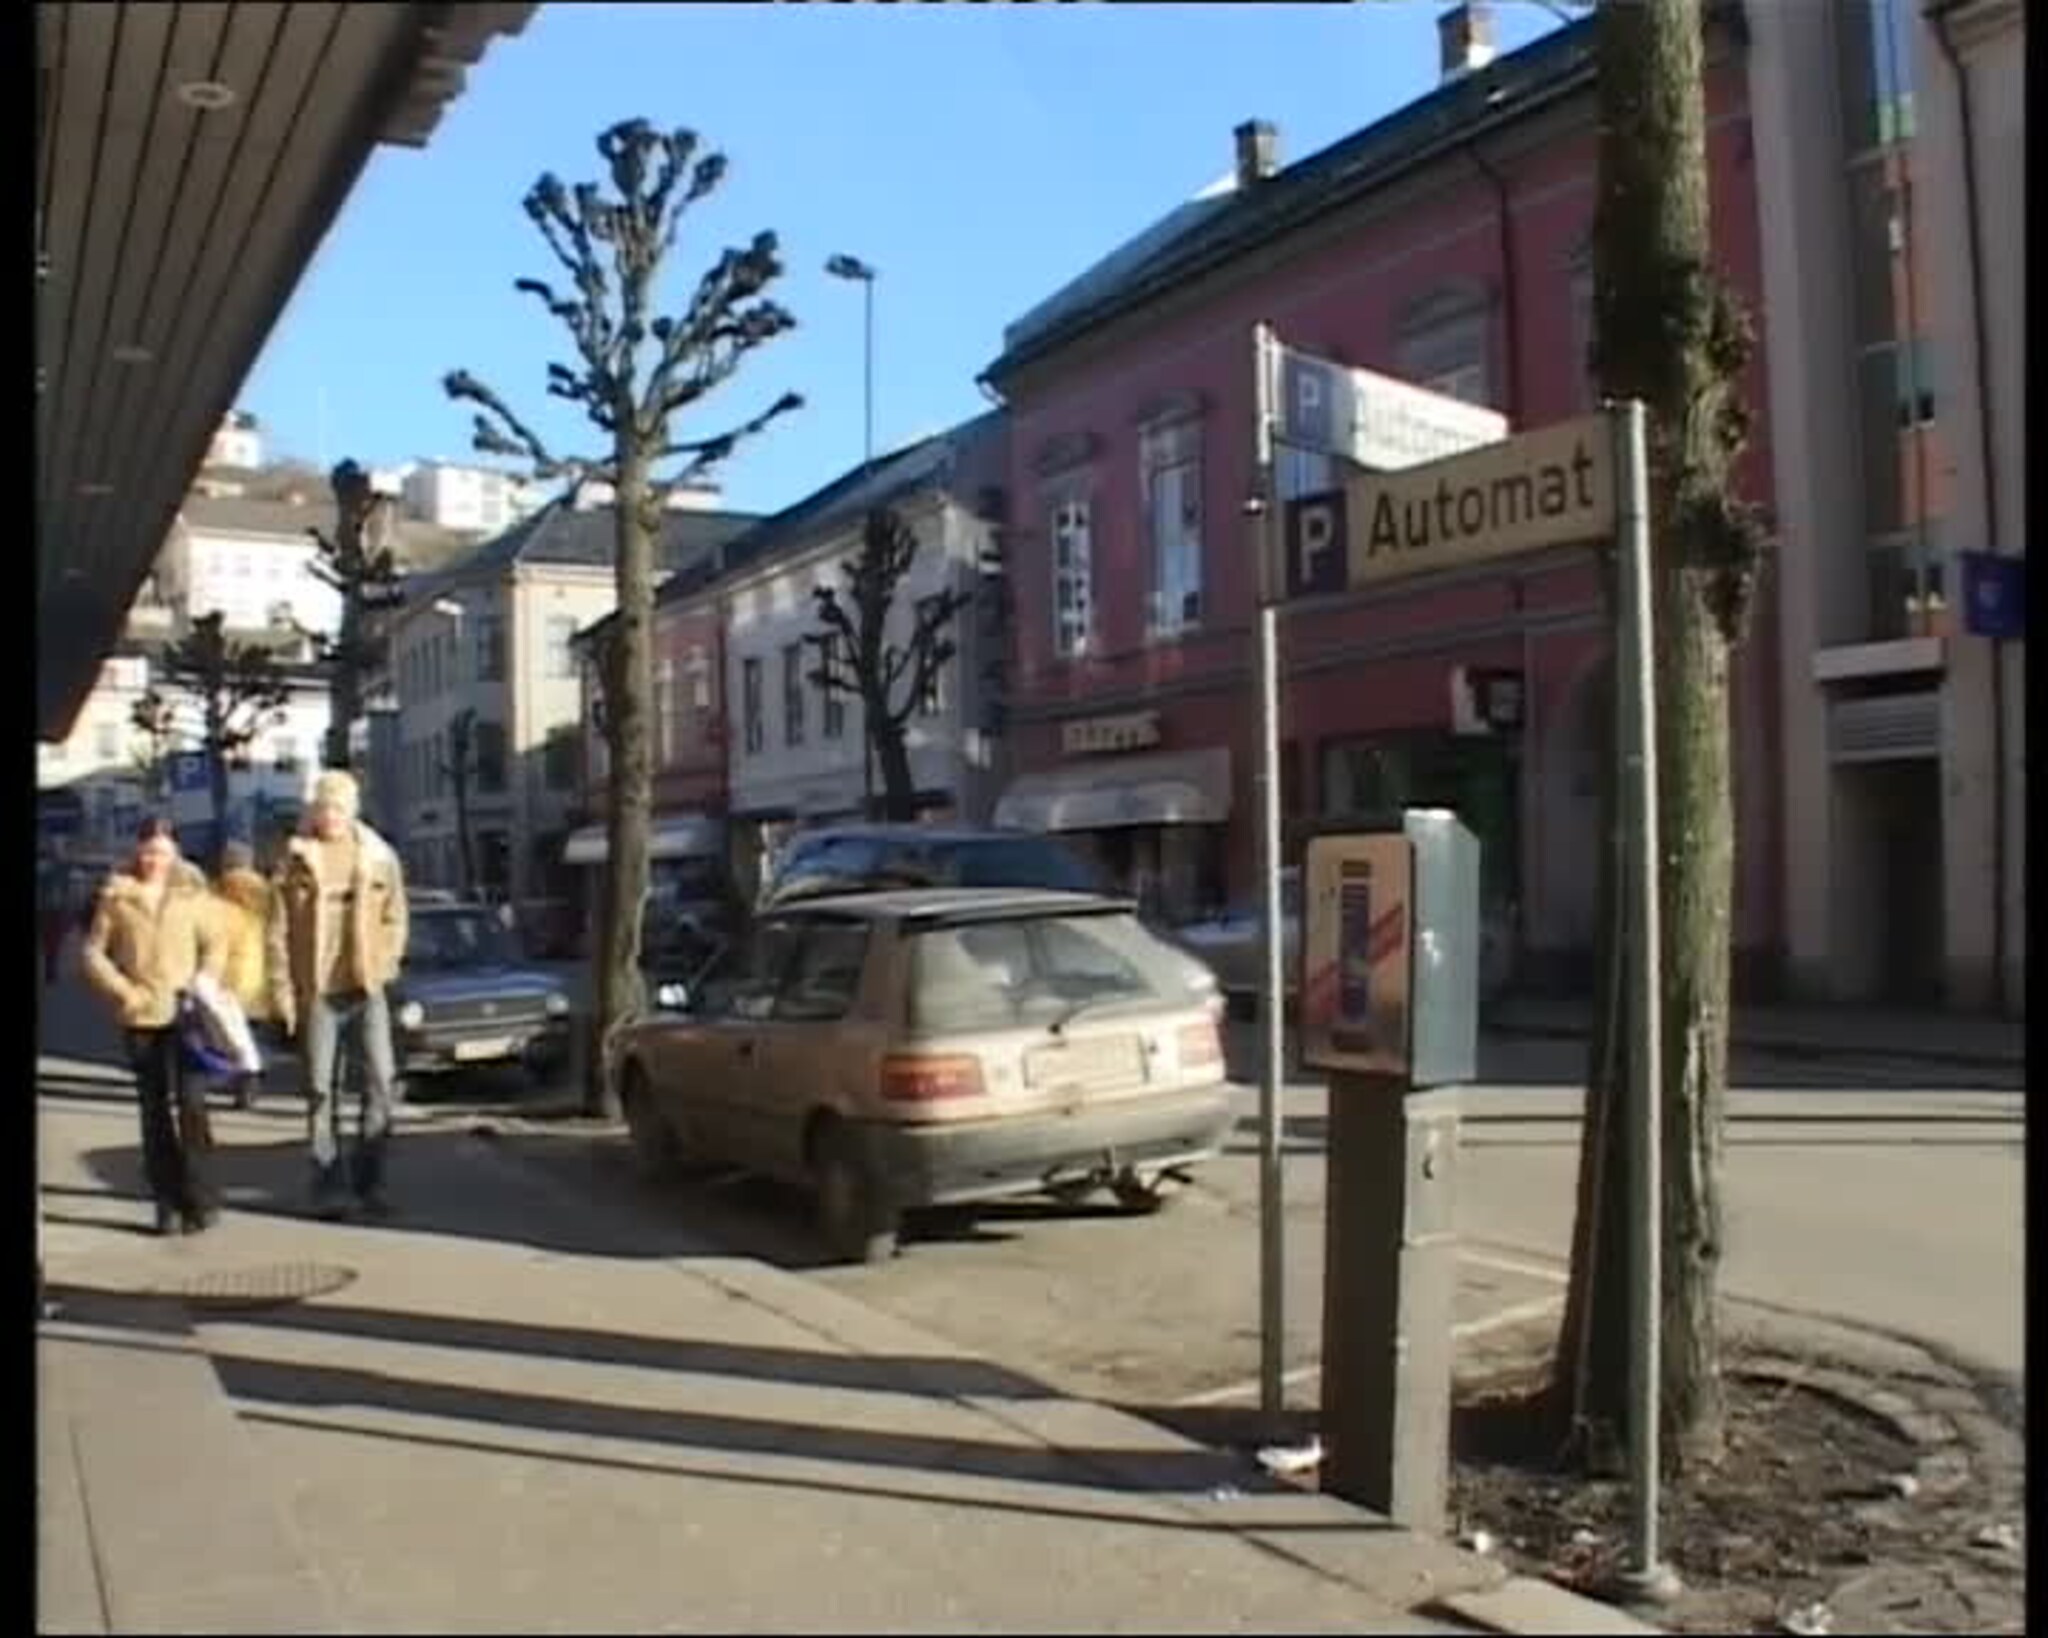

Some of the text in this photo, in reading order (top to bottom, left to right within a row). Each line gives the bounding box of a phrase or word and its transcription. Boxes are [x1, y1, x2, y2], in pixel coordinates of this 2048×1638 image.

[1297, 371, 1321, 432] P
[1301, 442, 1594, 582] P Automat
[176, 756, 199, 785] P
